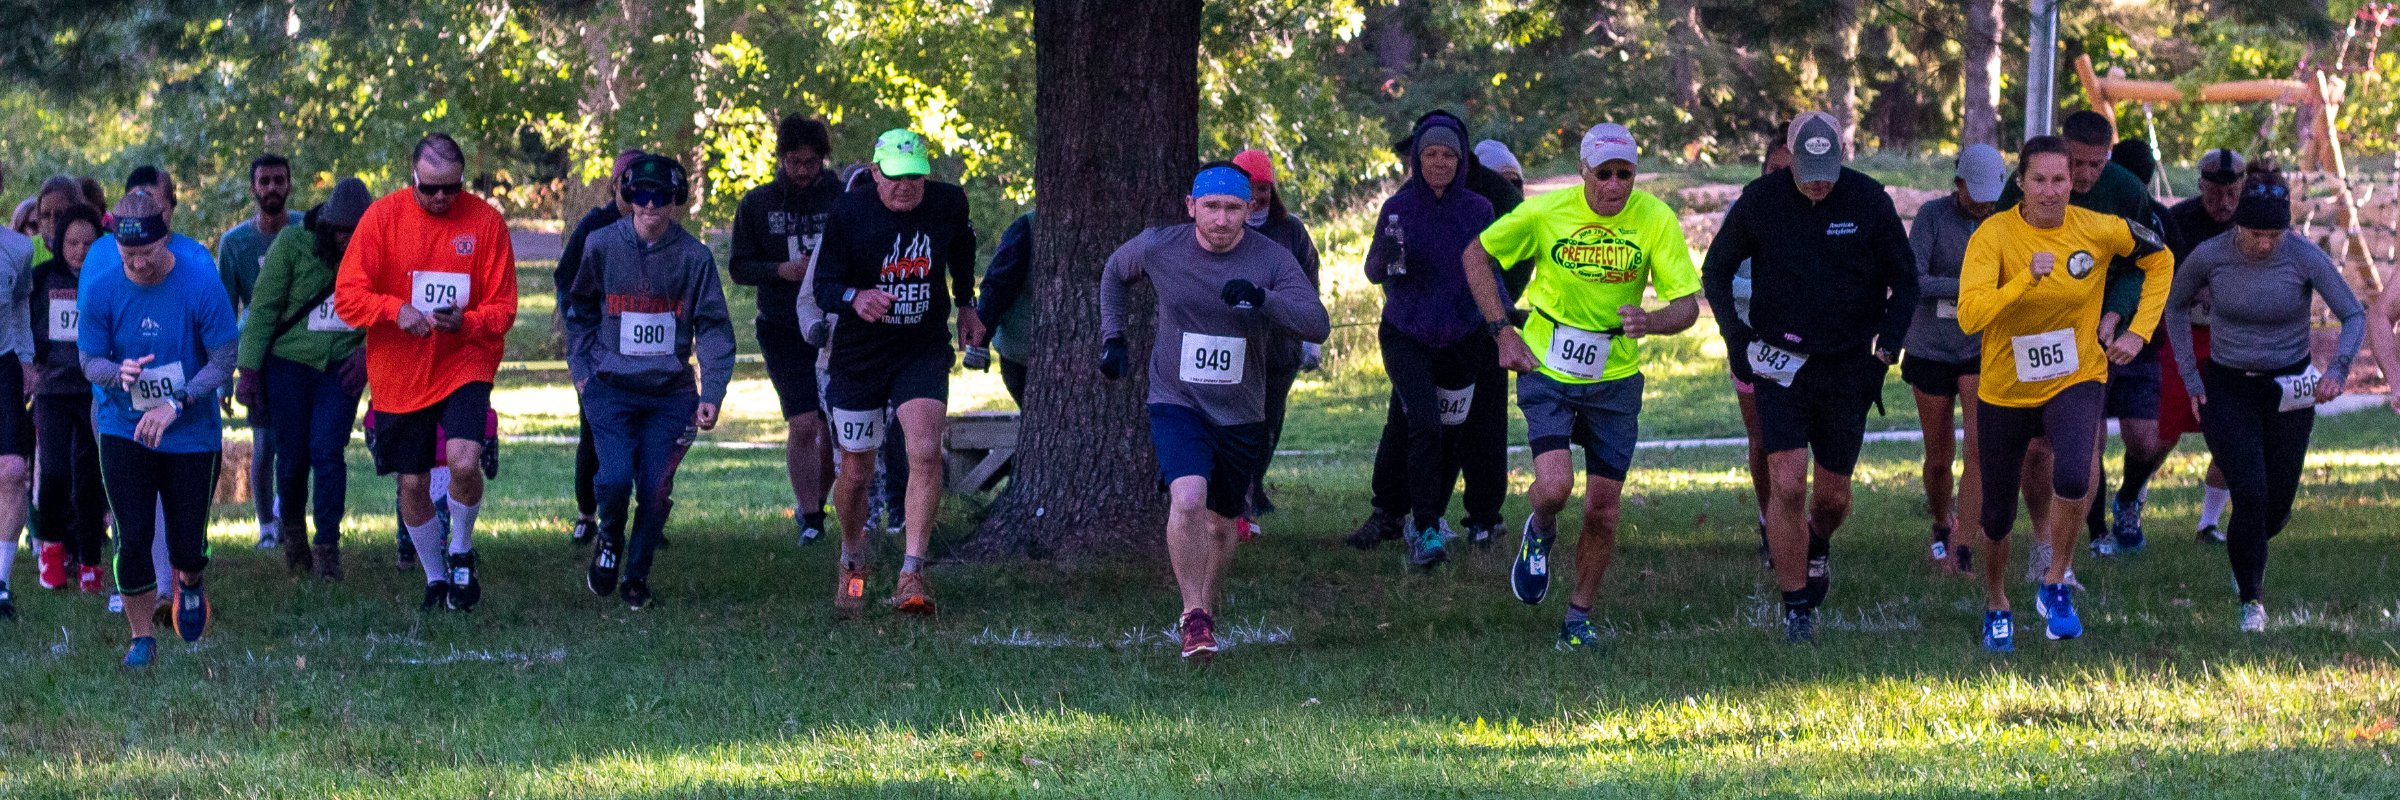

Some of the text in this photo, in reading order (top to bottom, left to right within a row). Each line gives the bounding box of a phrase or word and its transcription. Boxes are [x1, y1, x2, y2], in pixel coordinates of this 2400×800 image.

[424, 283, 457, 305] 979
[894, 301, 929, 315] MILER
[881, 315, 902, 324] TRAIL
[633, 324, 665, 344] 980
[1195, 347, 1231, 371] 949
[1561, 339, 1598, 365] 946
[1757, 344, 1791, 370] 943
[2028, 343, 2064, 368] 965
[139, 377, 174, 399] 959
[1440, 397, 1466, 415] 942
[843, 421, 874, 441] 974
